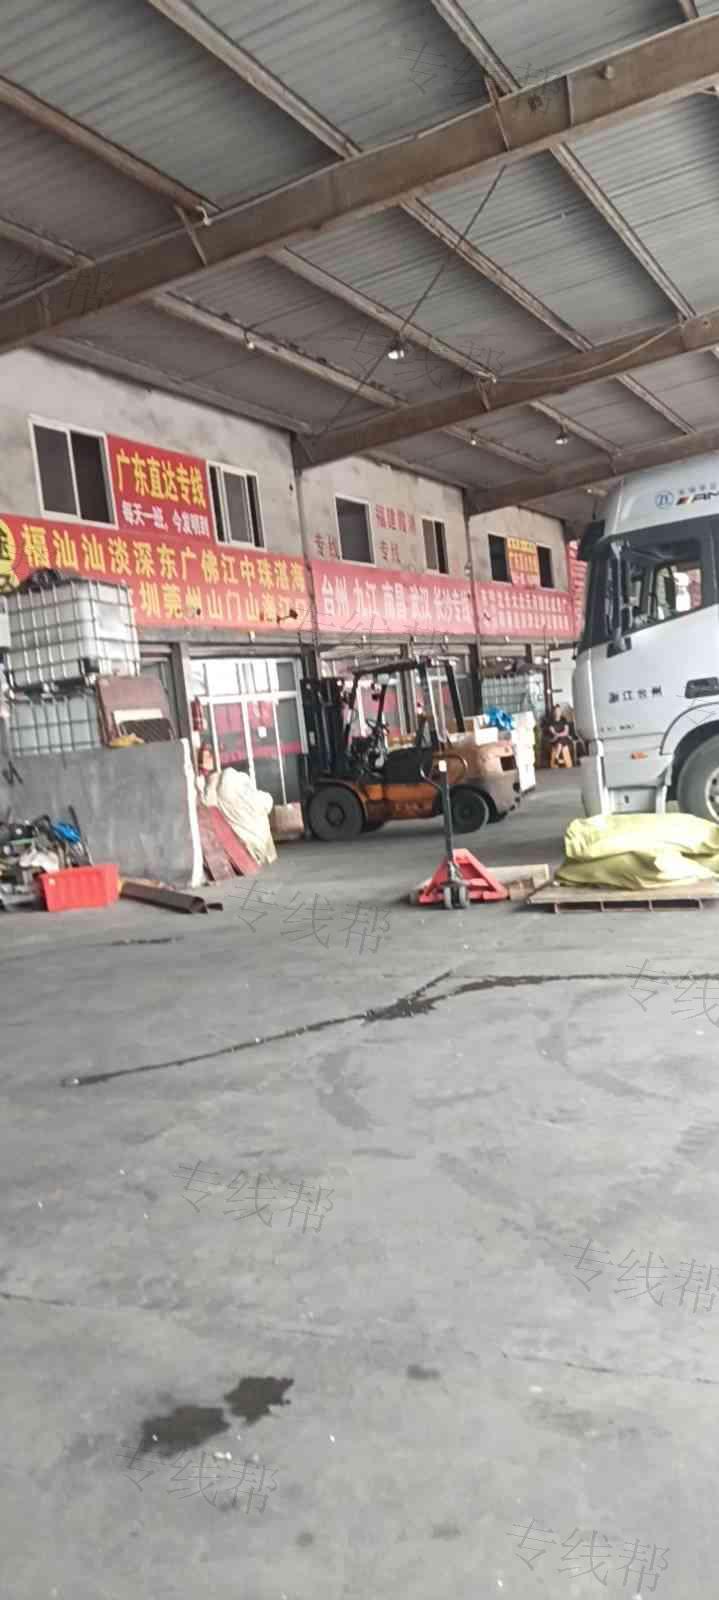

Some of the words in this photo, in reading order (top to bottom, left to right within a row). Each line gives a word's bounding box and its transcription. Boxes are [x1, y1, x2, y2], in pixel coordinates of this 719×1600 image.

[115, 448, 207, 508] 广东直达专线
[321, 575, 350, 616] 台州
